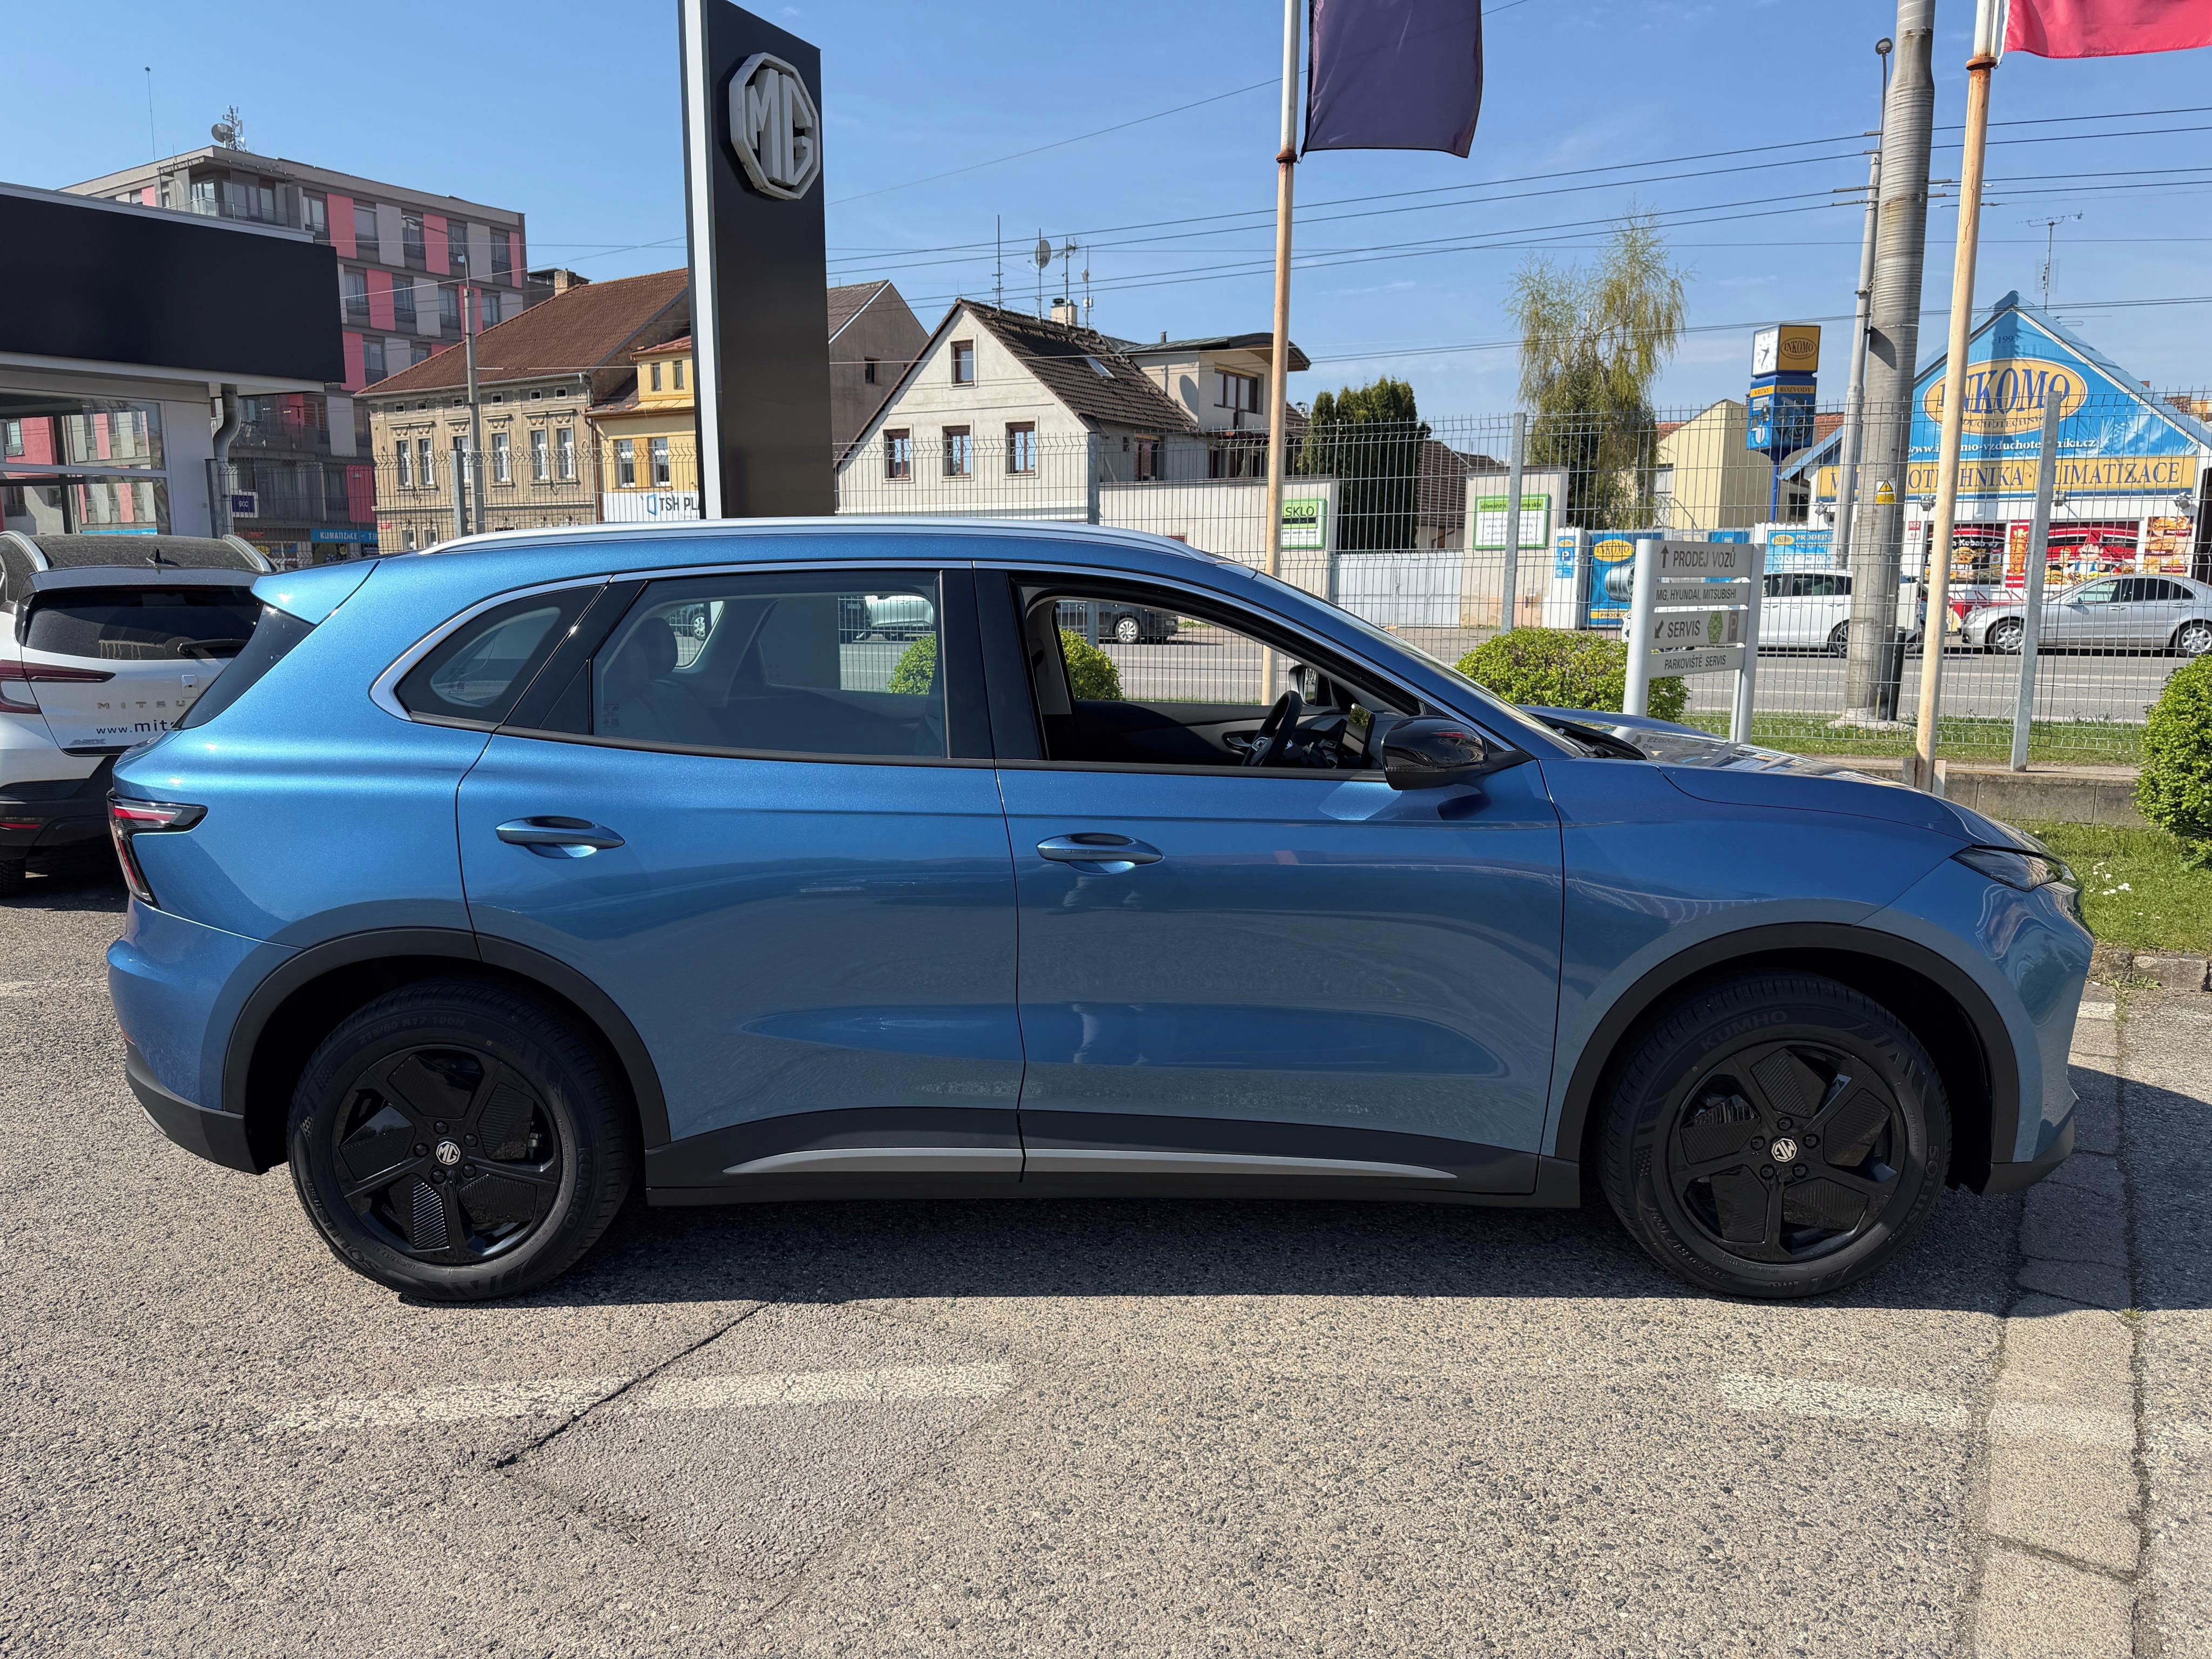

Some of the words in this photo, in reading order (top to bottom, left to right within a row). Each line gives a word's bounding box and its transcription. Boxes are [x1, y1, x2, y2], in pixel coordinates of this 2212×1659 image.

[745, 67, 814, 187] MG
[1784, 340, 1813, 354] INKOMO
[2039, 462, 2180, 485] LIMATIZACE
[659, 497, 679, 511] TSH
[684, 497, 699, 511] PL
[1285, 506, 1314, 517] SKLO
[1673, 550, 1708, 568] PRODEJ
[1712, 547, 1736, 568] VOZŮ
[1656, 589, 1669, 602] MG,
[1670, 589, 1701, 601] HYUNDAI,
[1703, 588, 1736, 601] MITSUBISHI
[1667, 621, 1701, 638] SERVIS
[1664, 655, 1702, 670] PARKOVIŠTĚ
[1705, 655, 1726, 667] SERVIS
[97, 700, 185, 709] MITSU
[359, 1021, 398, 1043] 215/60
[403, 1016, 427, 1029] R17
[431, 1015, 467, 1027] 100H
[1701, 1010, 1789, 1051] KUMHO
[438, 1144, 458, 1163] MG
[1911, 1145, 1940, 1222] SOLUS
